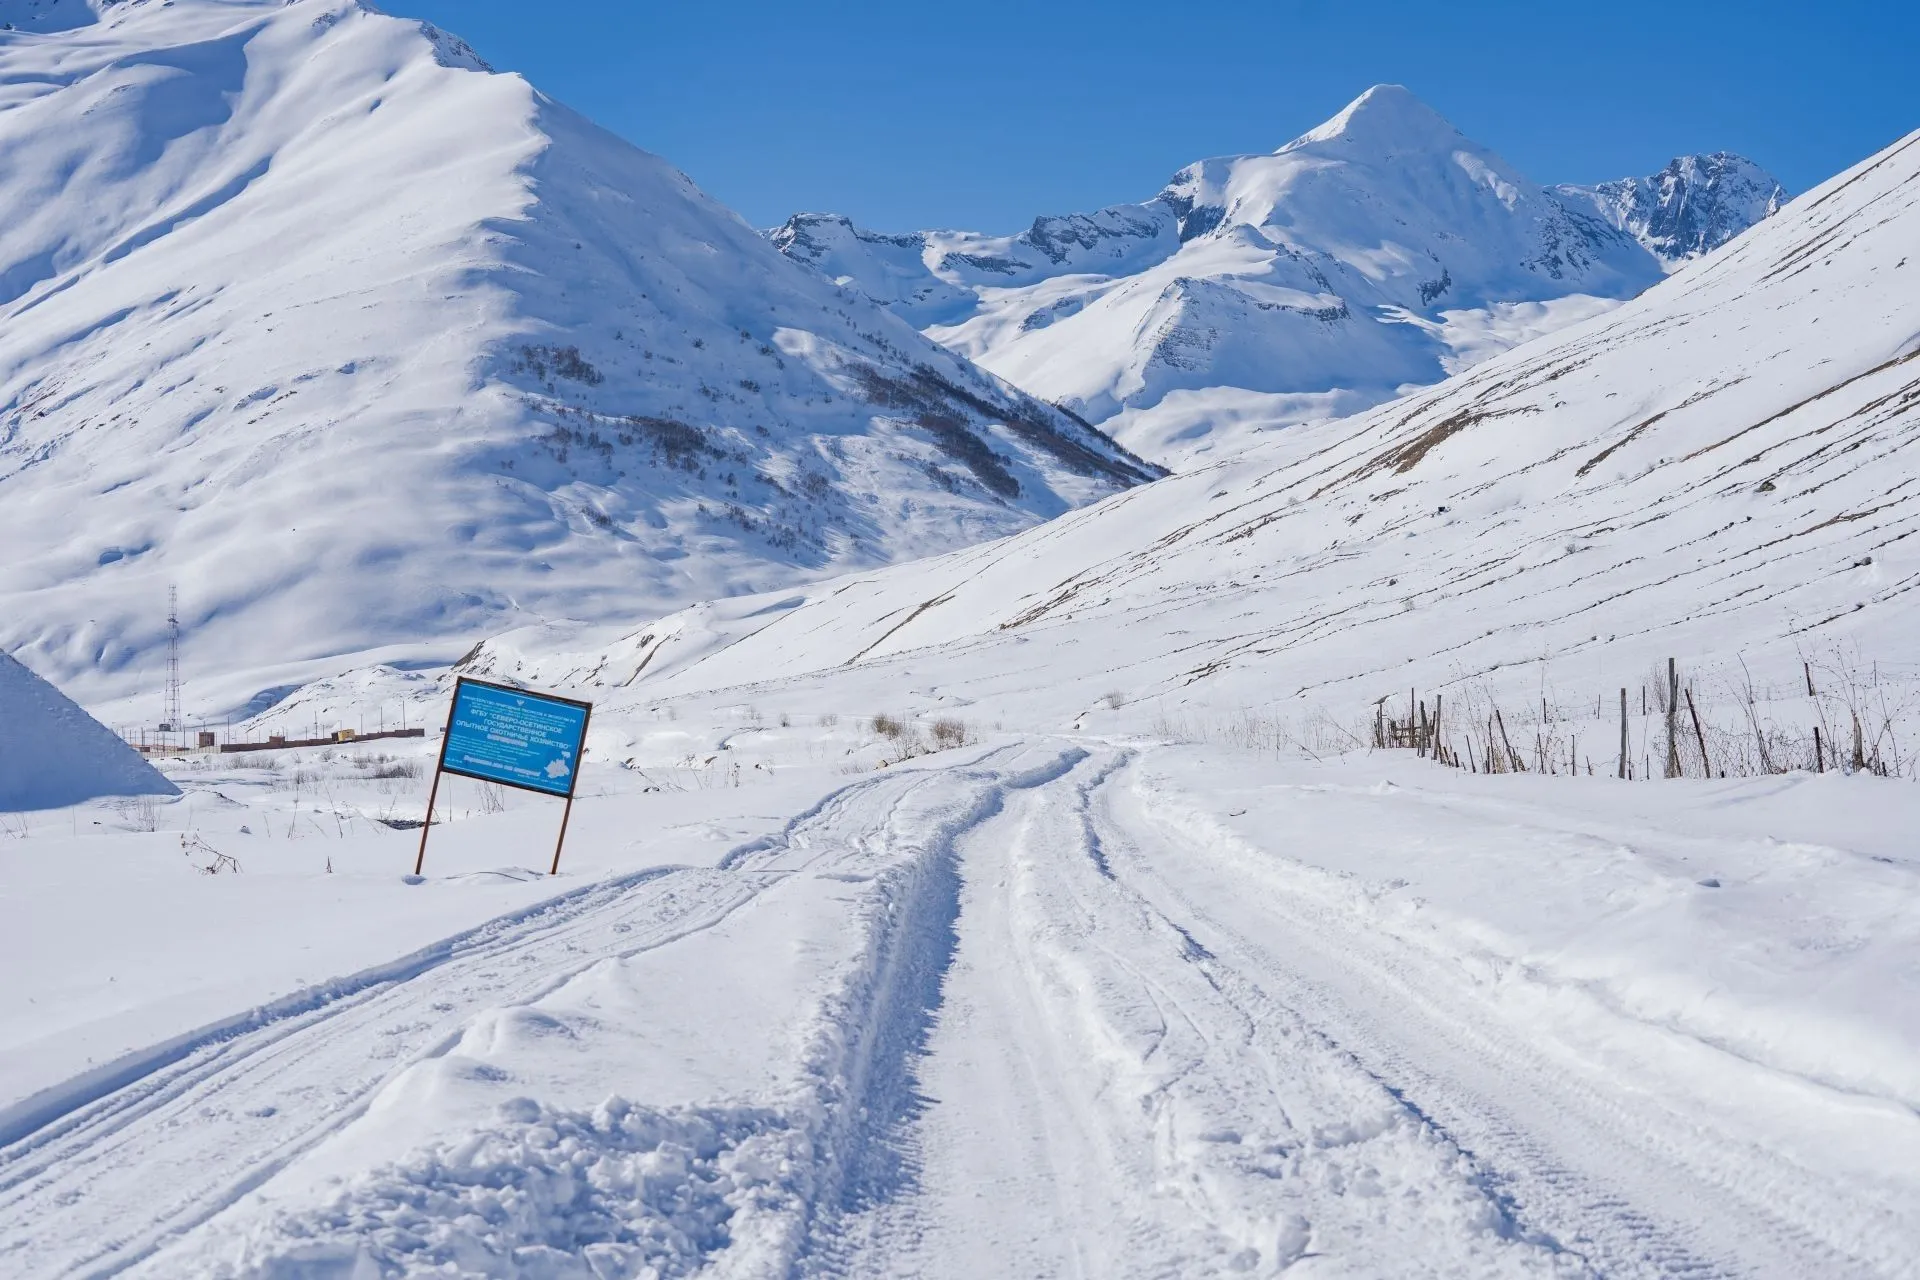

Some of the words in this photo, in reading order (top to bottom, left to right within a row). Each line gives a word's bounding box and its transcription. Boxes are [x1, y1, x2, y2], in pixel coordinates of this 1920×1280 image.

[470, 709, 488, 717] ФГБУ
[456, 720, 488, 733] ОПЫТНОЕ
[489, 727, 529, 741] ОХОТНИЧЬЕ
[484, 718, 547, 738] ГОСУДАРСТВЕННОЕ
